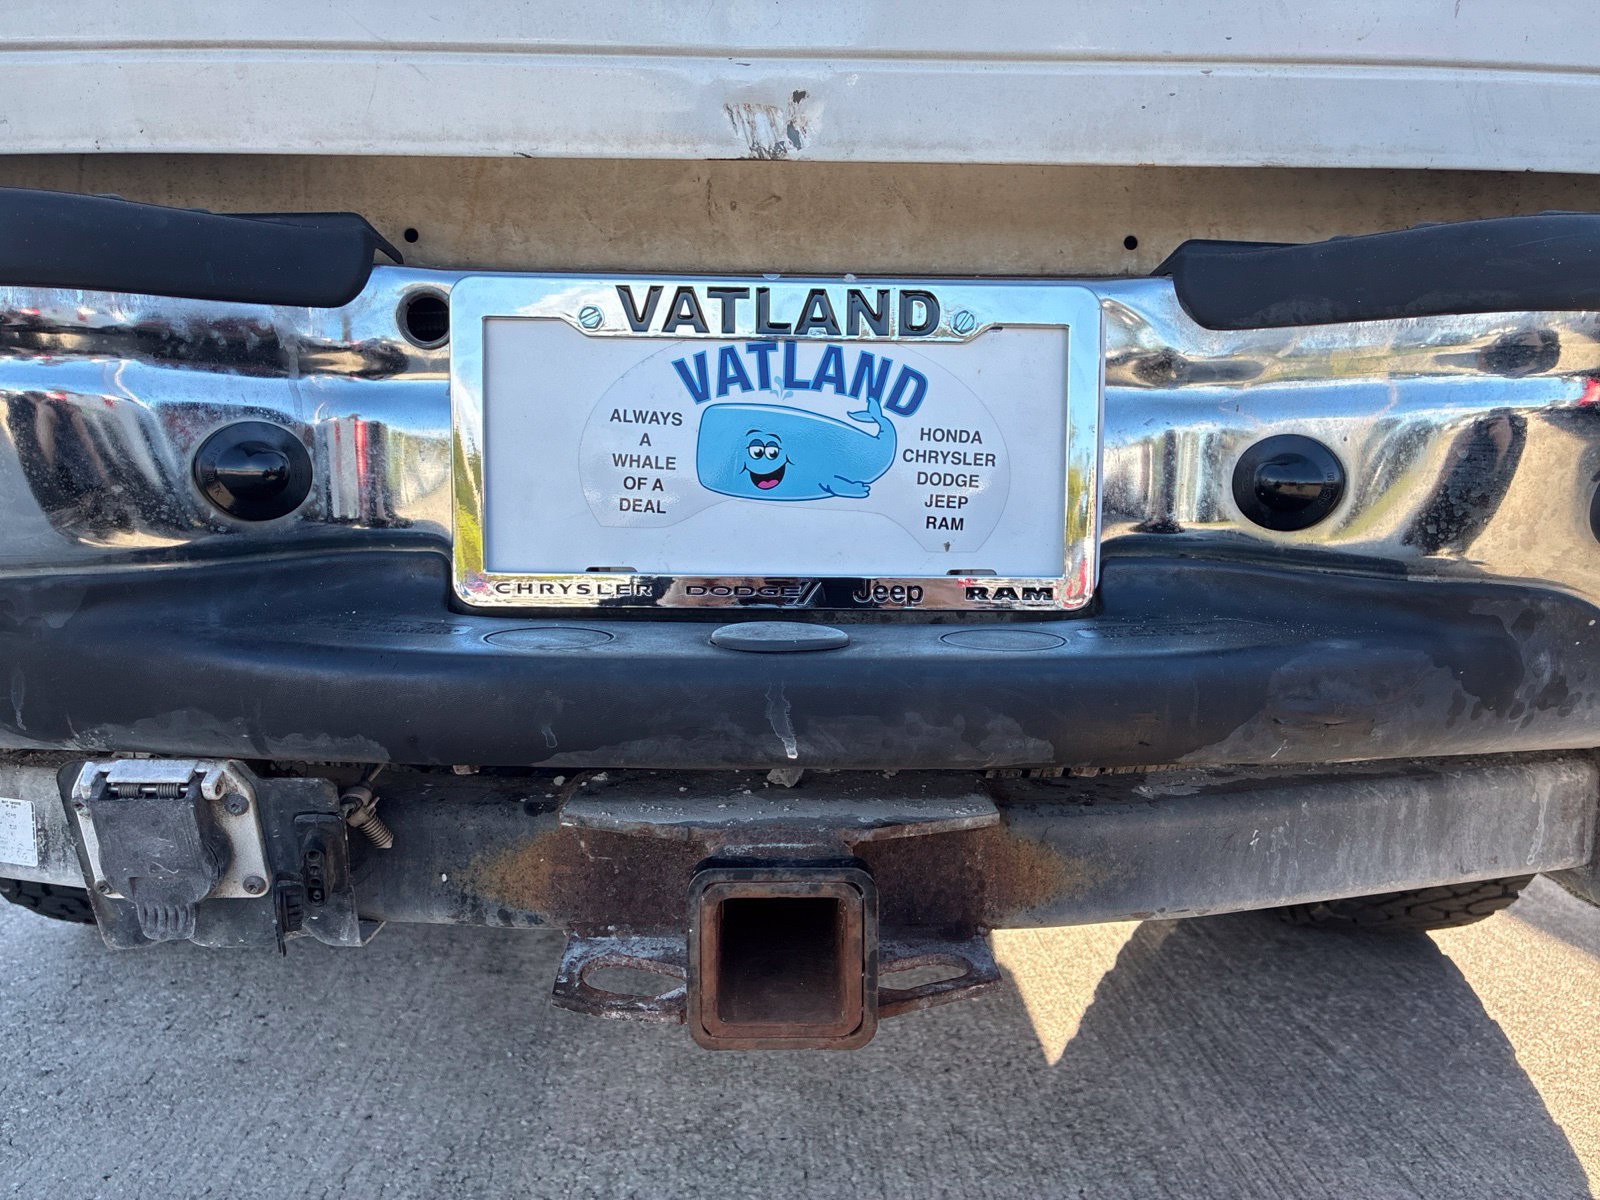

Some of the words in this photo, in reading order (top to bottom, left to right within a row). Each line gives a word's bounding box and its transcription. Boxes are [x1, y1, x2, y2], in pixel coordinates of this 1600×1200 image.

[615, 284, 942, 337] VATLAND
[671, 340, 929, 418] VATLAND
[609, 408, 683, 427] ALWAYS
[639, 432, 652, 447] A
[920, 427, 983, 445] HONDA
[612, 453, 677, 471] WHALE
[902, 448, 996, 467] CHRYSLER
[623, 476, 648, 491] OF
[652, 478, 664, 492] A
[916, 471, 980, 489] DODGE
[619, 498, 666, 514] DEAL
[924, 494, 969, 510] JEEP
[925, 515, 964, 532] RAM
[494, 582, 653, 597] CHRYSLER
[685, 584, 802, 597] DODGE
[853, 578, 924, 606] Jeep
[964, 585, 1055, 601] RAM
